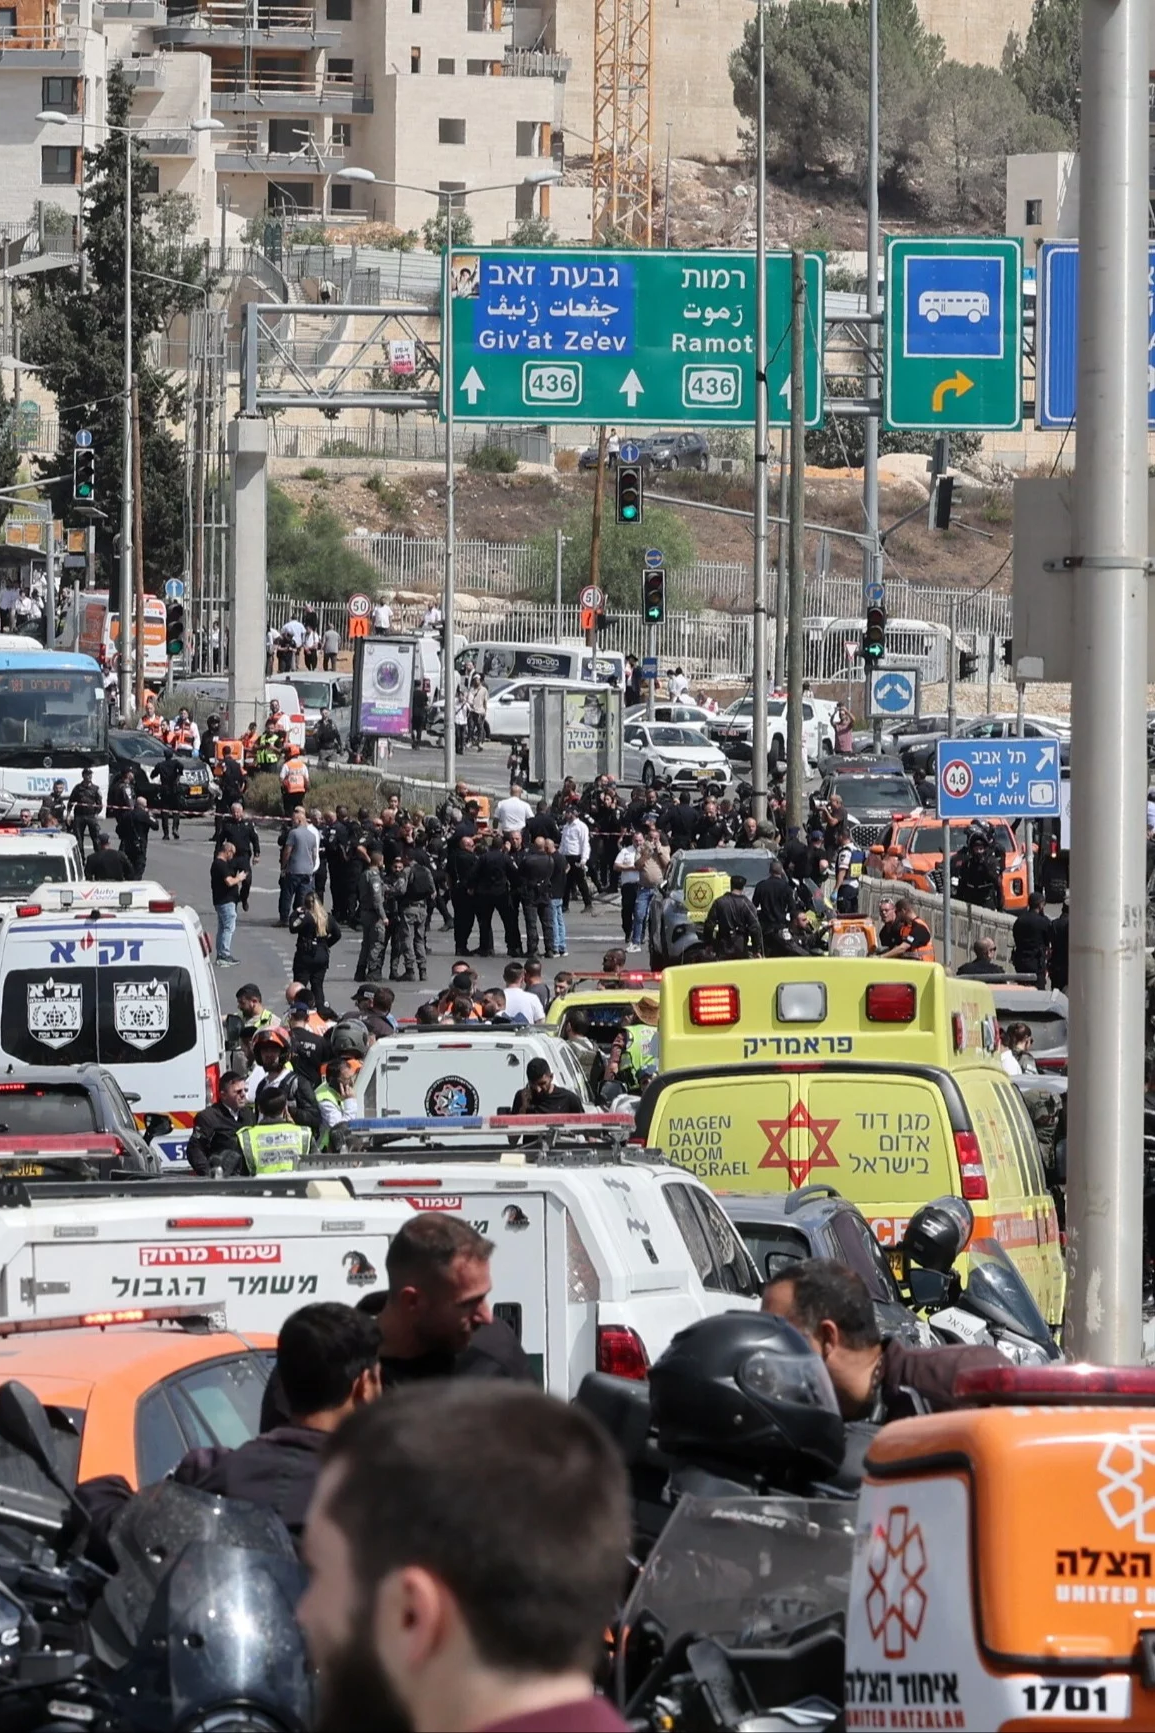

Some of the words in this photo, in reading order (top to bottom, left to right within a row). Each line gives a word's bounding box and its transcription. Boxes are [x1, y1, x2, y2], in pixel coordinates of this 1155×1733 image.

[488, 264, 536, 286] זאב
[550, 266, 619, 289] גבעת
[681, 268, 745, 289] רמות
[479, 329, 553, 349] Giv'at
[564, 330, 627, 351] Ze'ev
[672, 333, 753, 353] Ramot
[532, 374, 573, 392] 436
[692, 377, 732, 395] 436
[353, 601, 366, 612] 50
[971, 751, 1001, 765] אביב
[1007, 748, 1026, 764] תל
[949, 772, 966, 785] 4.8
[1006, 771, 1020, 789] تل
[973, 792, 992, 805] Tel
[998, 792, 1025, 805] Aviv
[743, 1036, 853, 1058] פראמדיק
[668, 1115, 732, 1132] MAGEN
[855, 1112, 889, 1130] דוד
[898, 1113, 930, 1134] מגן
[669, 1131, 722, 1147] DAVID
[879, 1135, 930, 1152] אדום
[670, 1147, 723, 1162] ADOM
[849, 1153, 929, 1175] בישראל
[412, 1197, 461, 1209] שמור
[142, 1247, 208, 1265] מרחק
[216, 1245, 279, 1261] שמור
[112, 1274, 206, 1297] הגבול
[228, 1274, 318, 1295] משמר
[1056, 1547, 1152, 1578] הצלה
[1055, 1584, 1138, 1604] UNITED
[845, 1668, 893, 1704] הצלה
[897, 1671, 961, 1704] איחוד
[1022, 1685, 1108, 1712] 1701
[890, 1709, 966, 1728] HATZALAH
